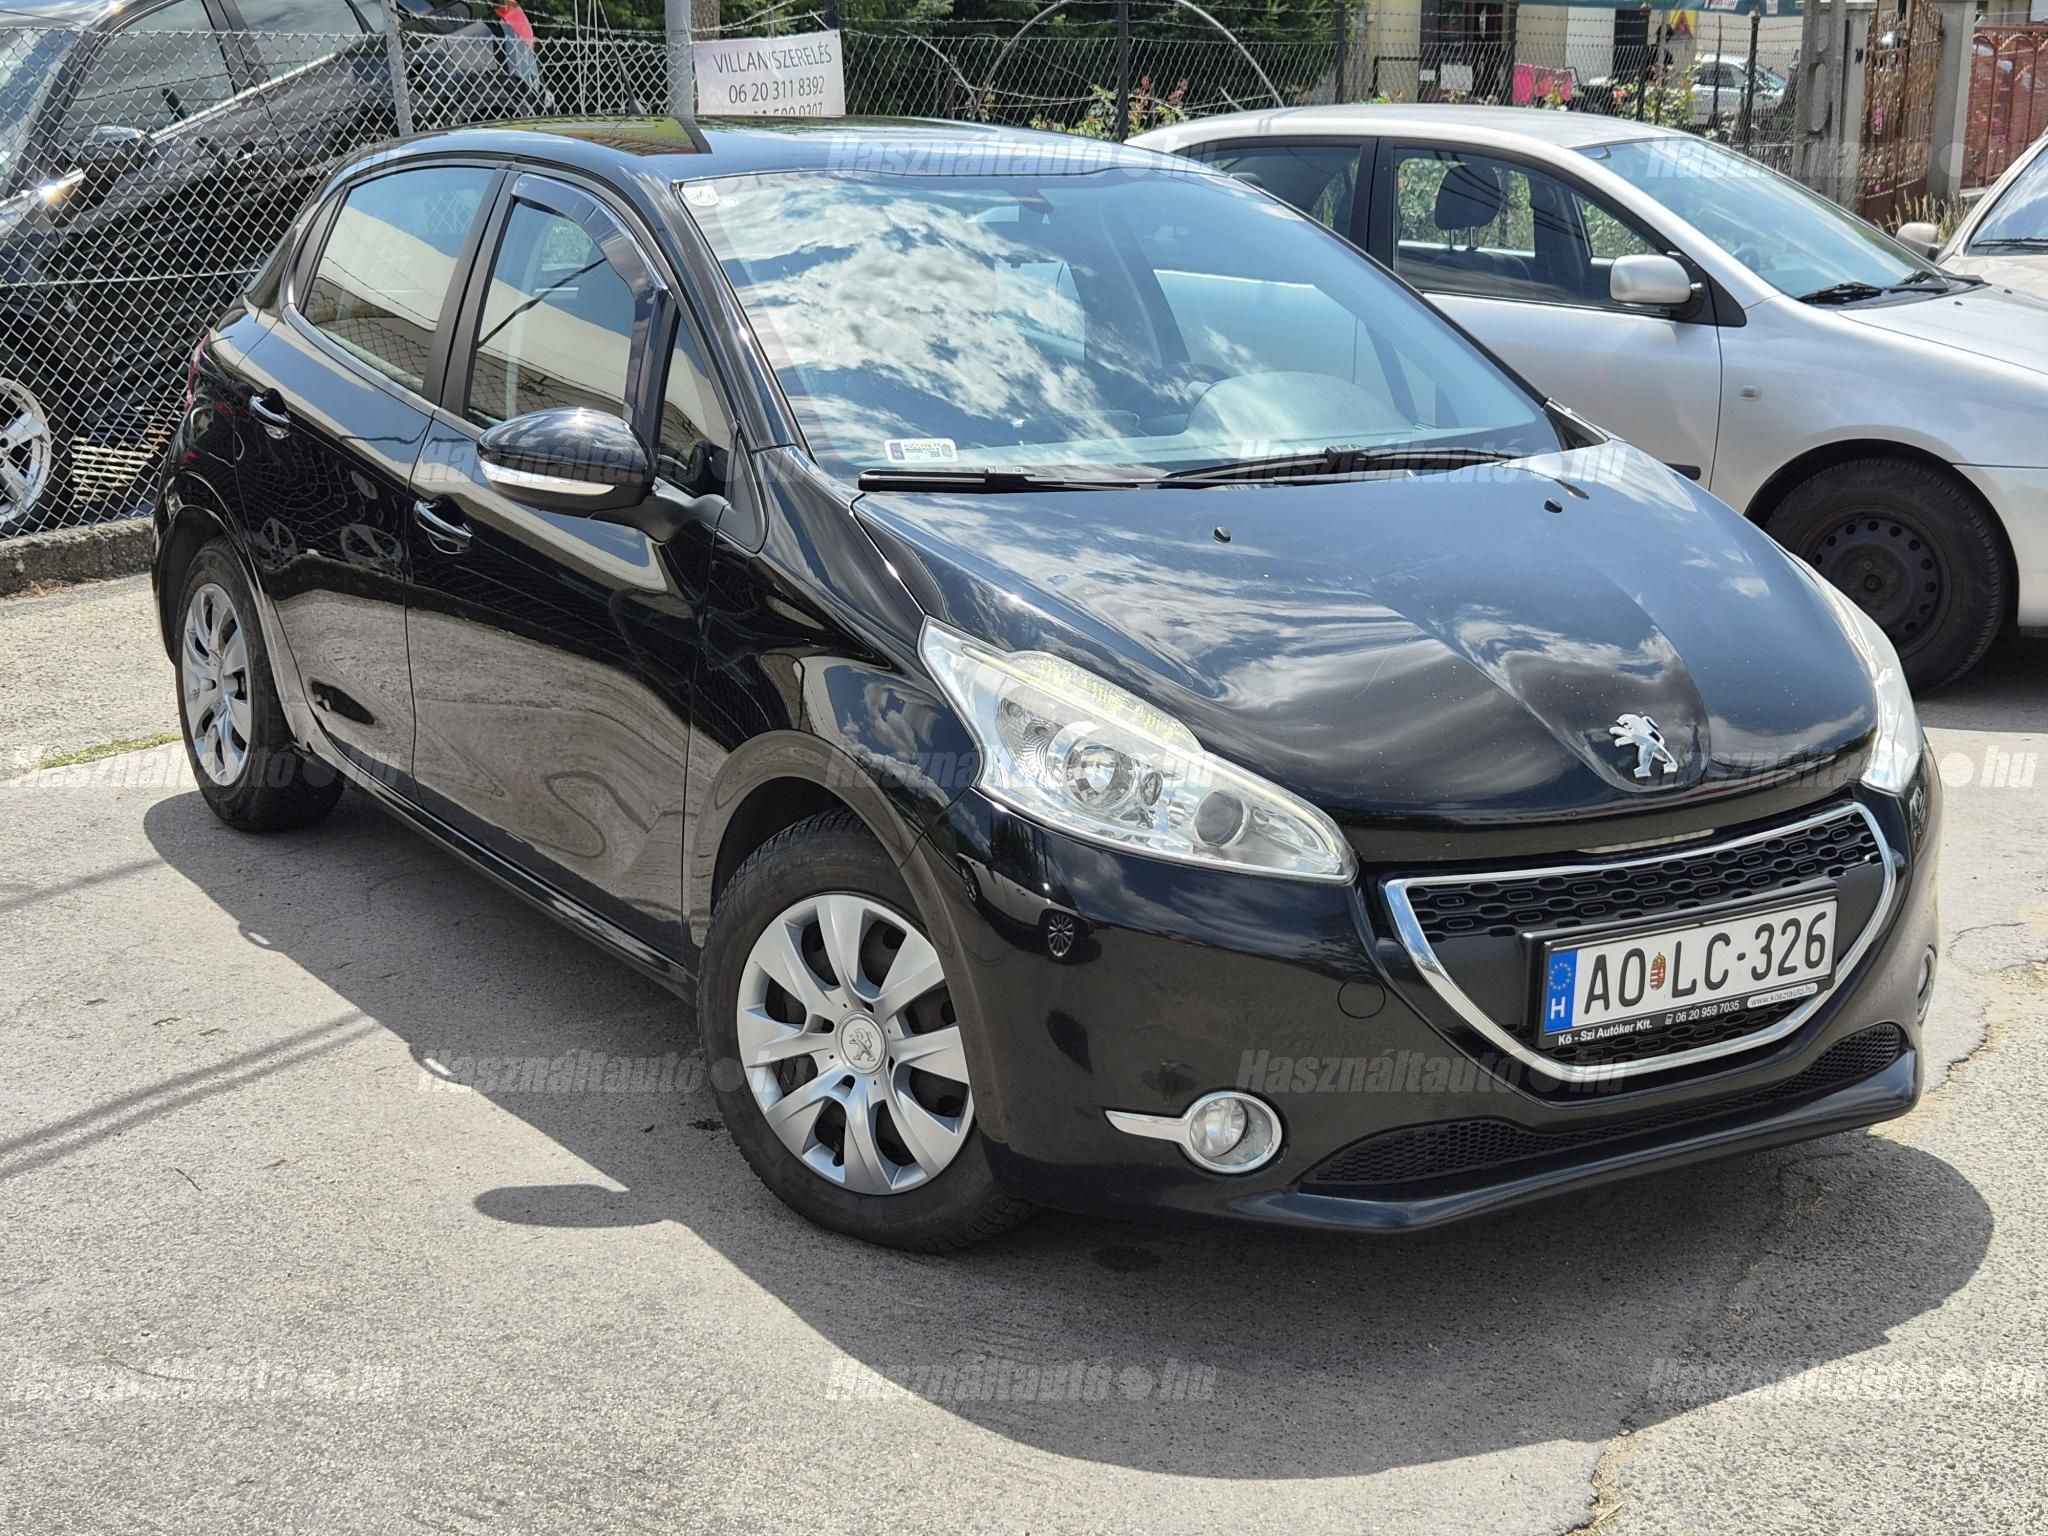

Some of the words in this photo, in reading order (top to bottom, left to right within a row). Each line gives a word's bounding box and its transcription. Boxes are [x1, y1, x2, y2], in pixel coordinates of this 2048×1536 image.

[713, 41, 832, 73] VILLANYSZERELÉS
[728, 84, 747, 104] 06
[751, 82, 769, 102] 20
[772, 80, 794, 100] 311
[798, 76, 825, 97] 8392
[1550, 996, 1566, 1020] H
[1597, 1022, 1635, 1038] Autóker
[1636, 1019, 1653, 1032] Kft.
[1675, 1012, 1687, 1023] 06
[1688, 1009, 1700, 1020] 20
[1701, 1005, 1718, 1018] 959
[1719, 1000, 1740, 1014] 7035
